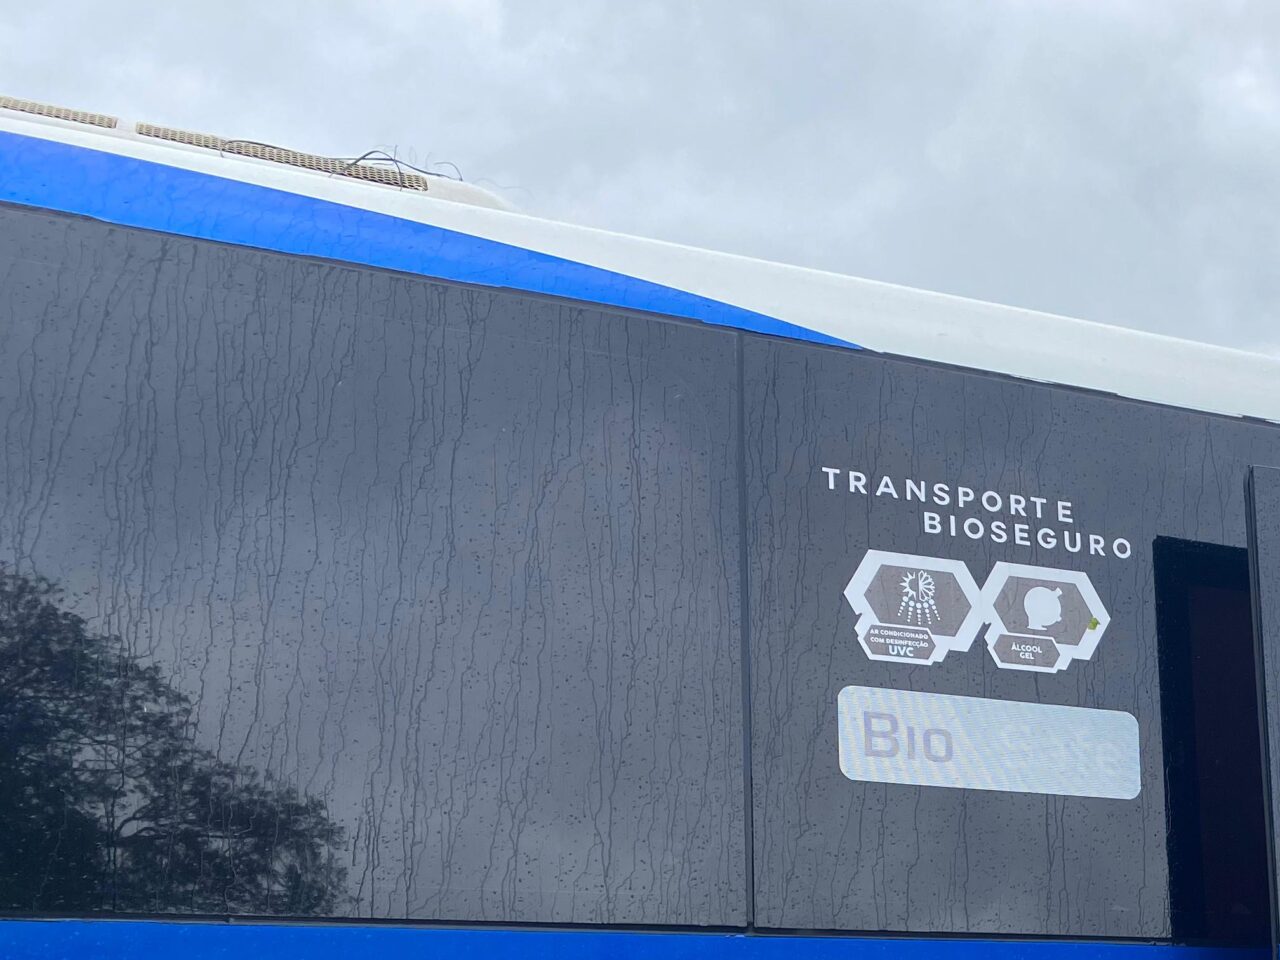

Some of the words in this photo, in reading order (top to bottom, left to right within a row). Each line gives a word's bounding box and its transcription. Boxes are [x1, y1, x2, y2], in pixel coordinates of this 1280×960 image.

[822, 467, 1073, 523] TRANSPORTE
[923, 511, 1132, 559] BIOSEGURO
[880, 629, 929, 640] CONDICIONADO
[888, 645, 914, 657] UVC
[1019, 651, 1035, 660] GEL
